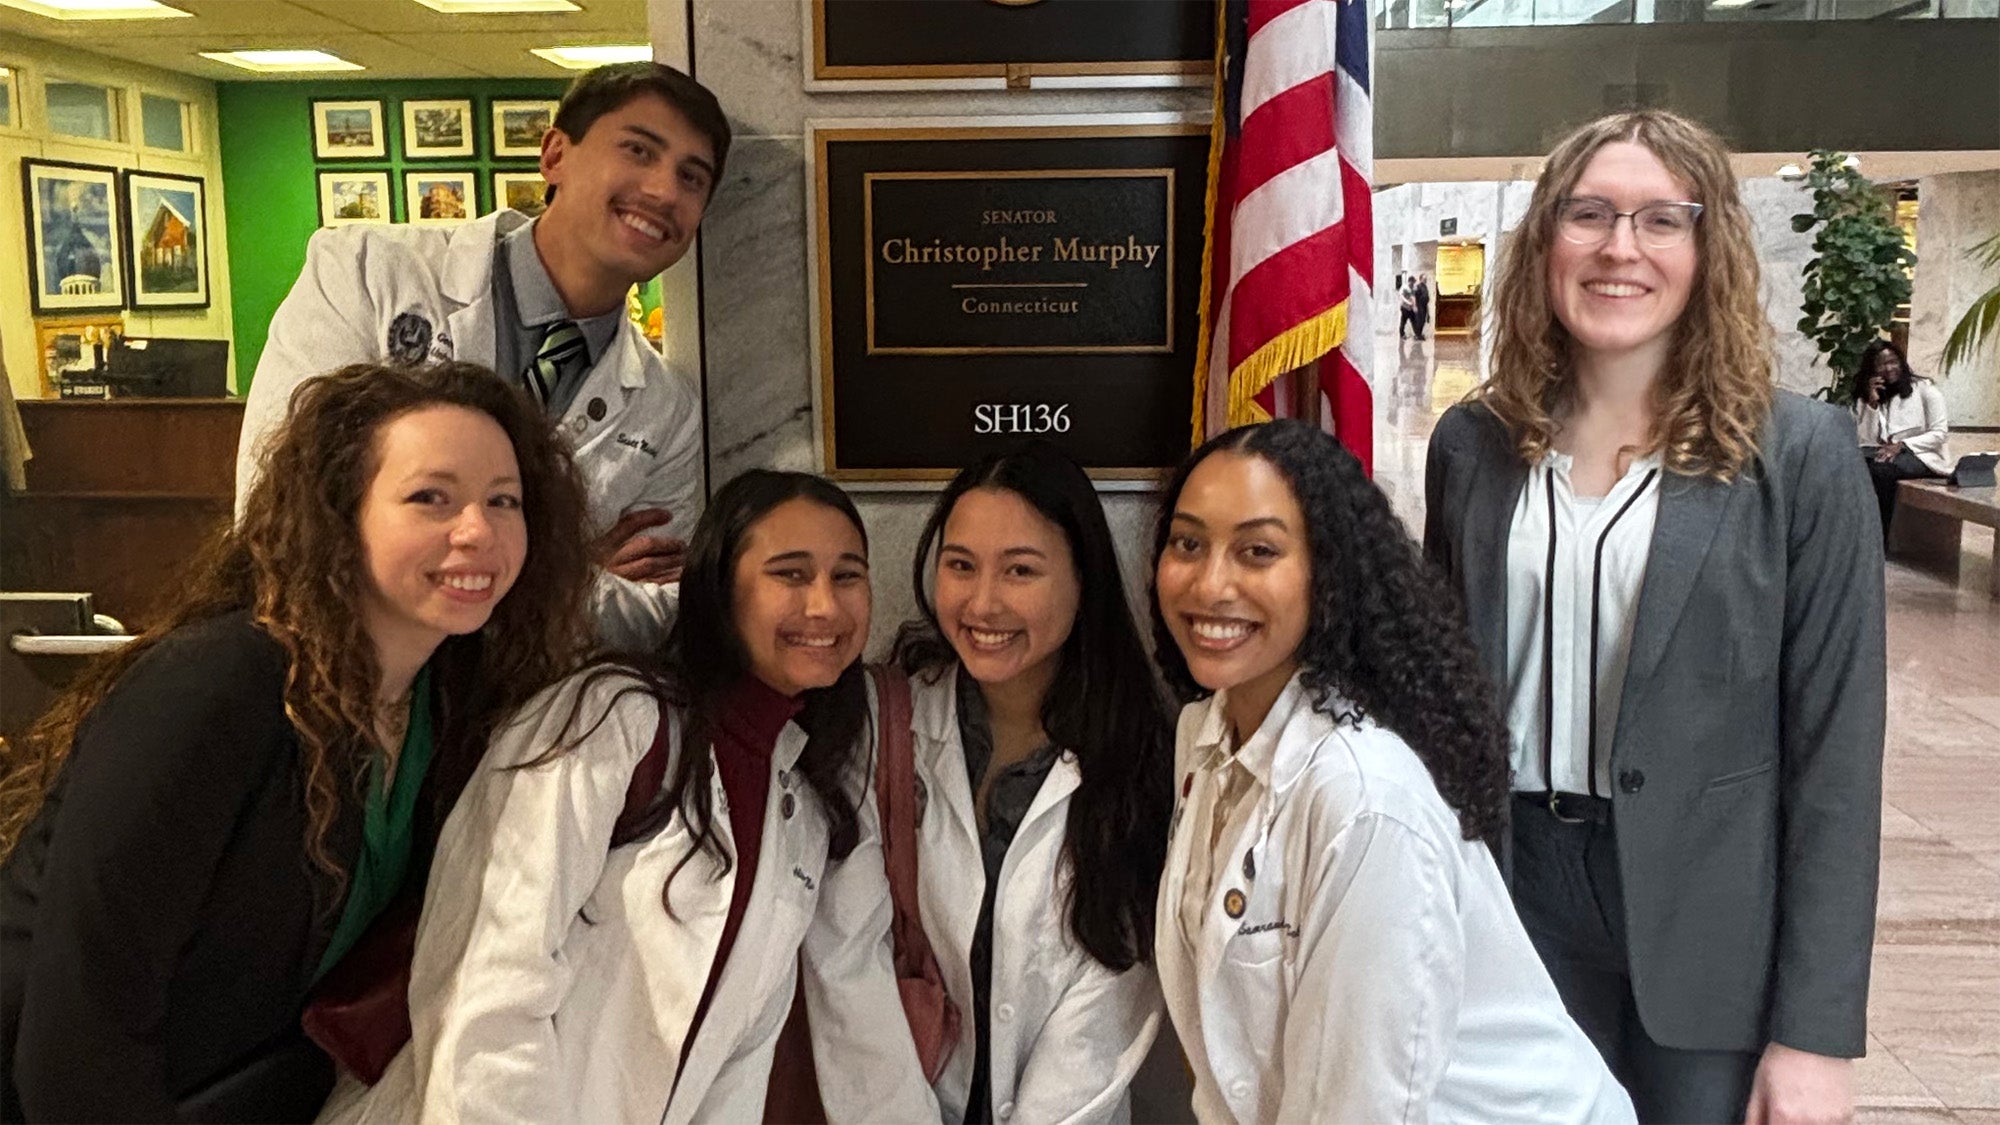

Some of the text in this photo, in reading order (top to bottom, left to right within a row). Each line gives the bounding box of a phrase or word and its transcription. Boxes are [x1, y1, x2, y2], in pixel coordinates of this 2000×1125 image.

[982, 210, 1057, 224] SENATOR
[882, 235, 1160, 270] Christopher Murphy
[962, 298, 1079, 313] Connecticut
[974, 403, 1071, 433] SH136
